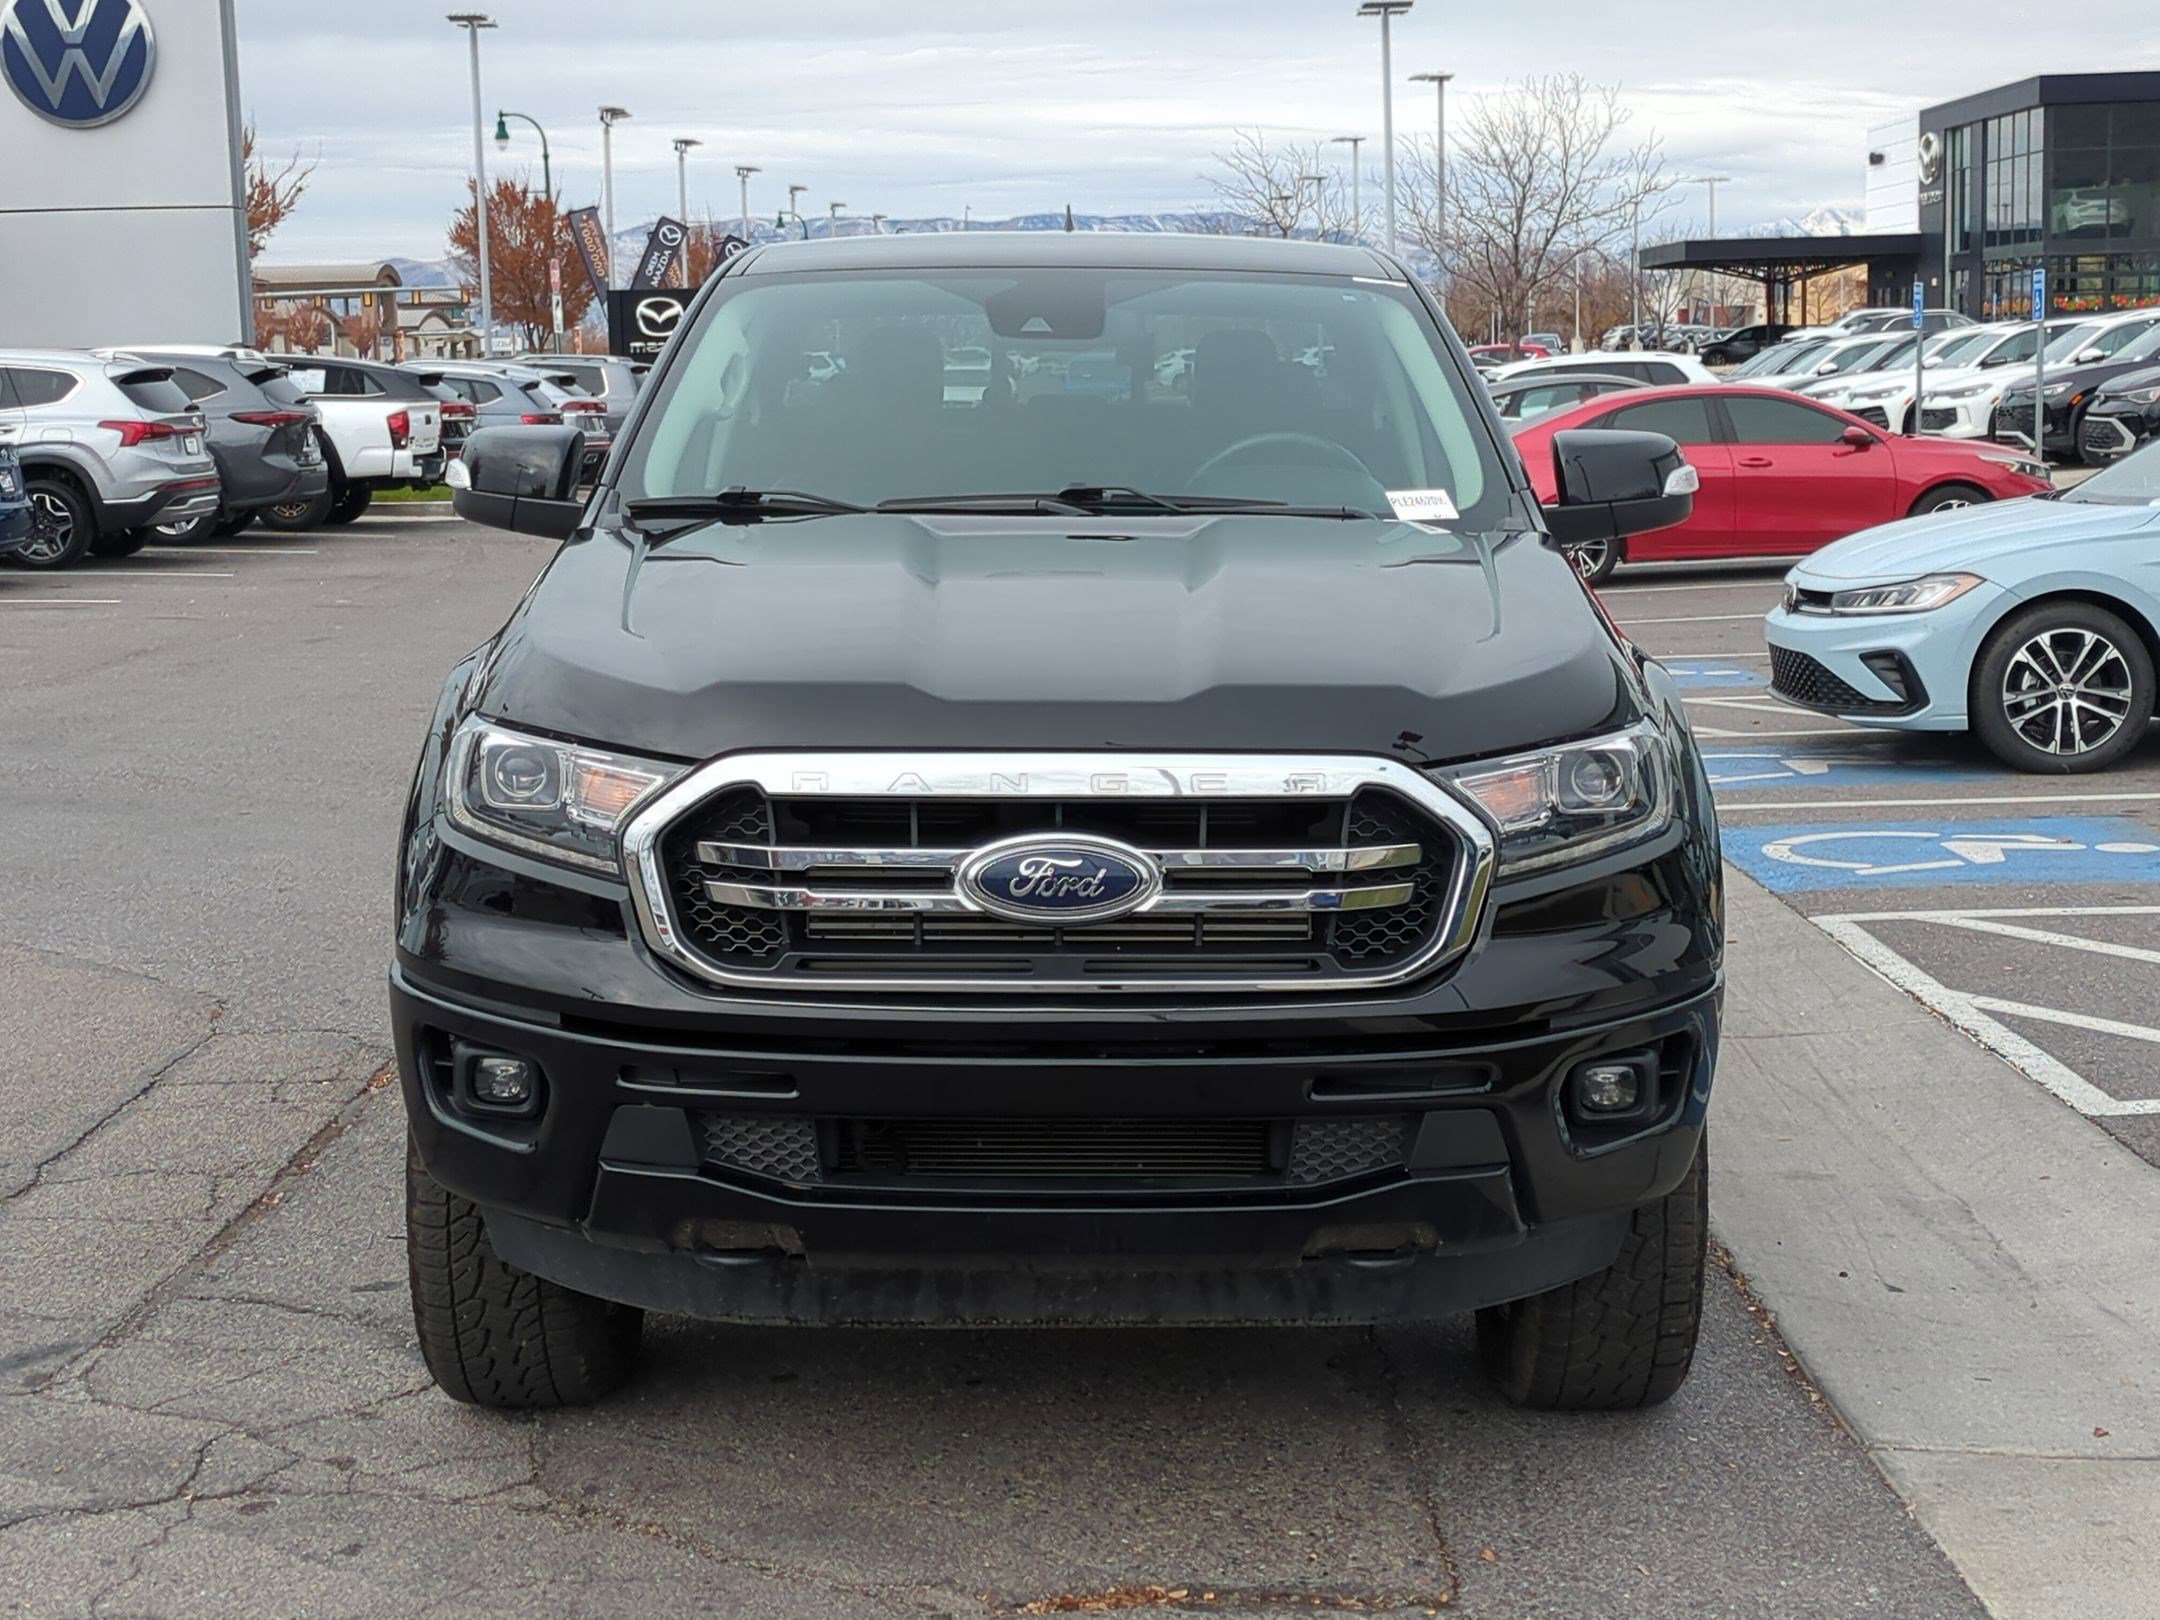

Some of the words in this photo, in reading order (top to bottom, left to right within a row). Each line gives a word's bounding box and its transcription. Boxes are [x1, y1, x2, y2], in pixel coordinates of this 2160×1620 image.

[650, 250, 672, 287] MAZDA
[791, 771, 1328, 793] RANGER
[1009, 857, 1107, 897] Ford
